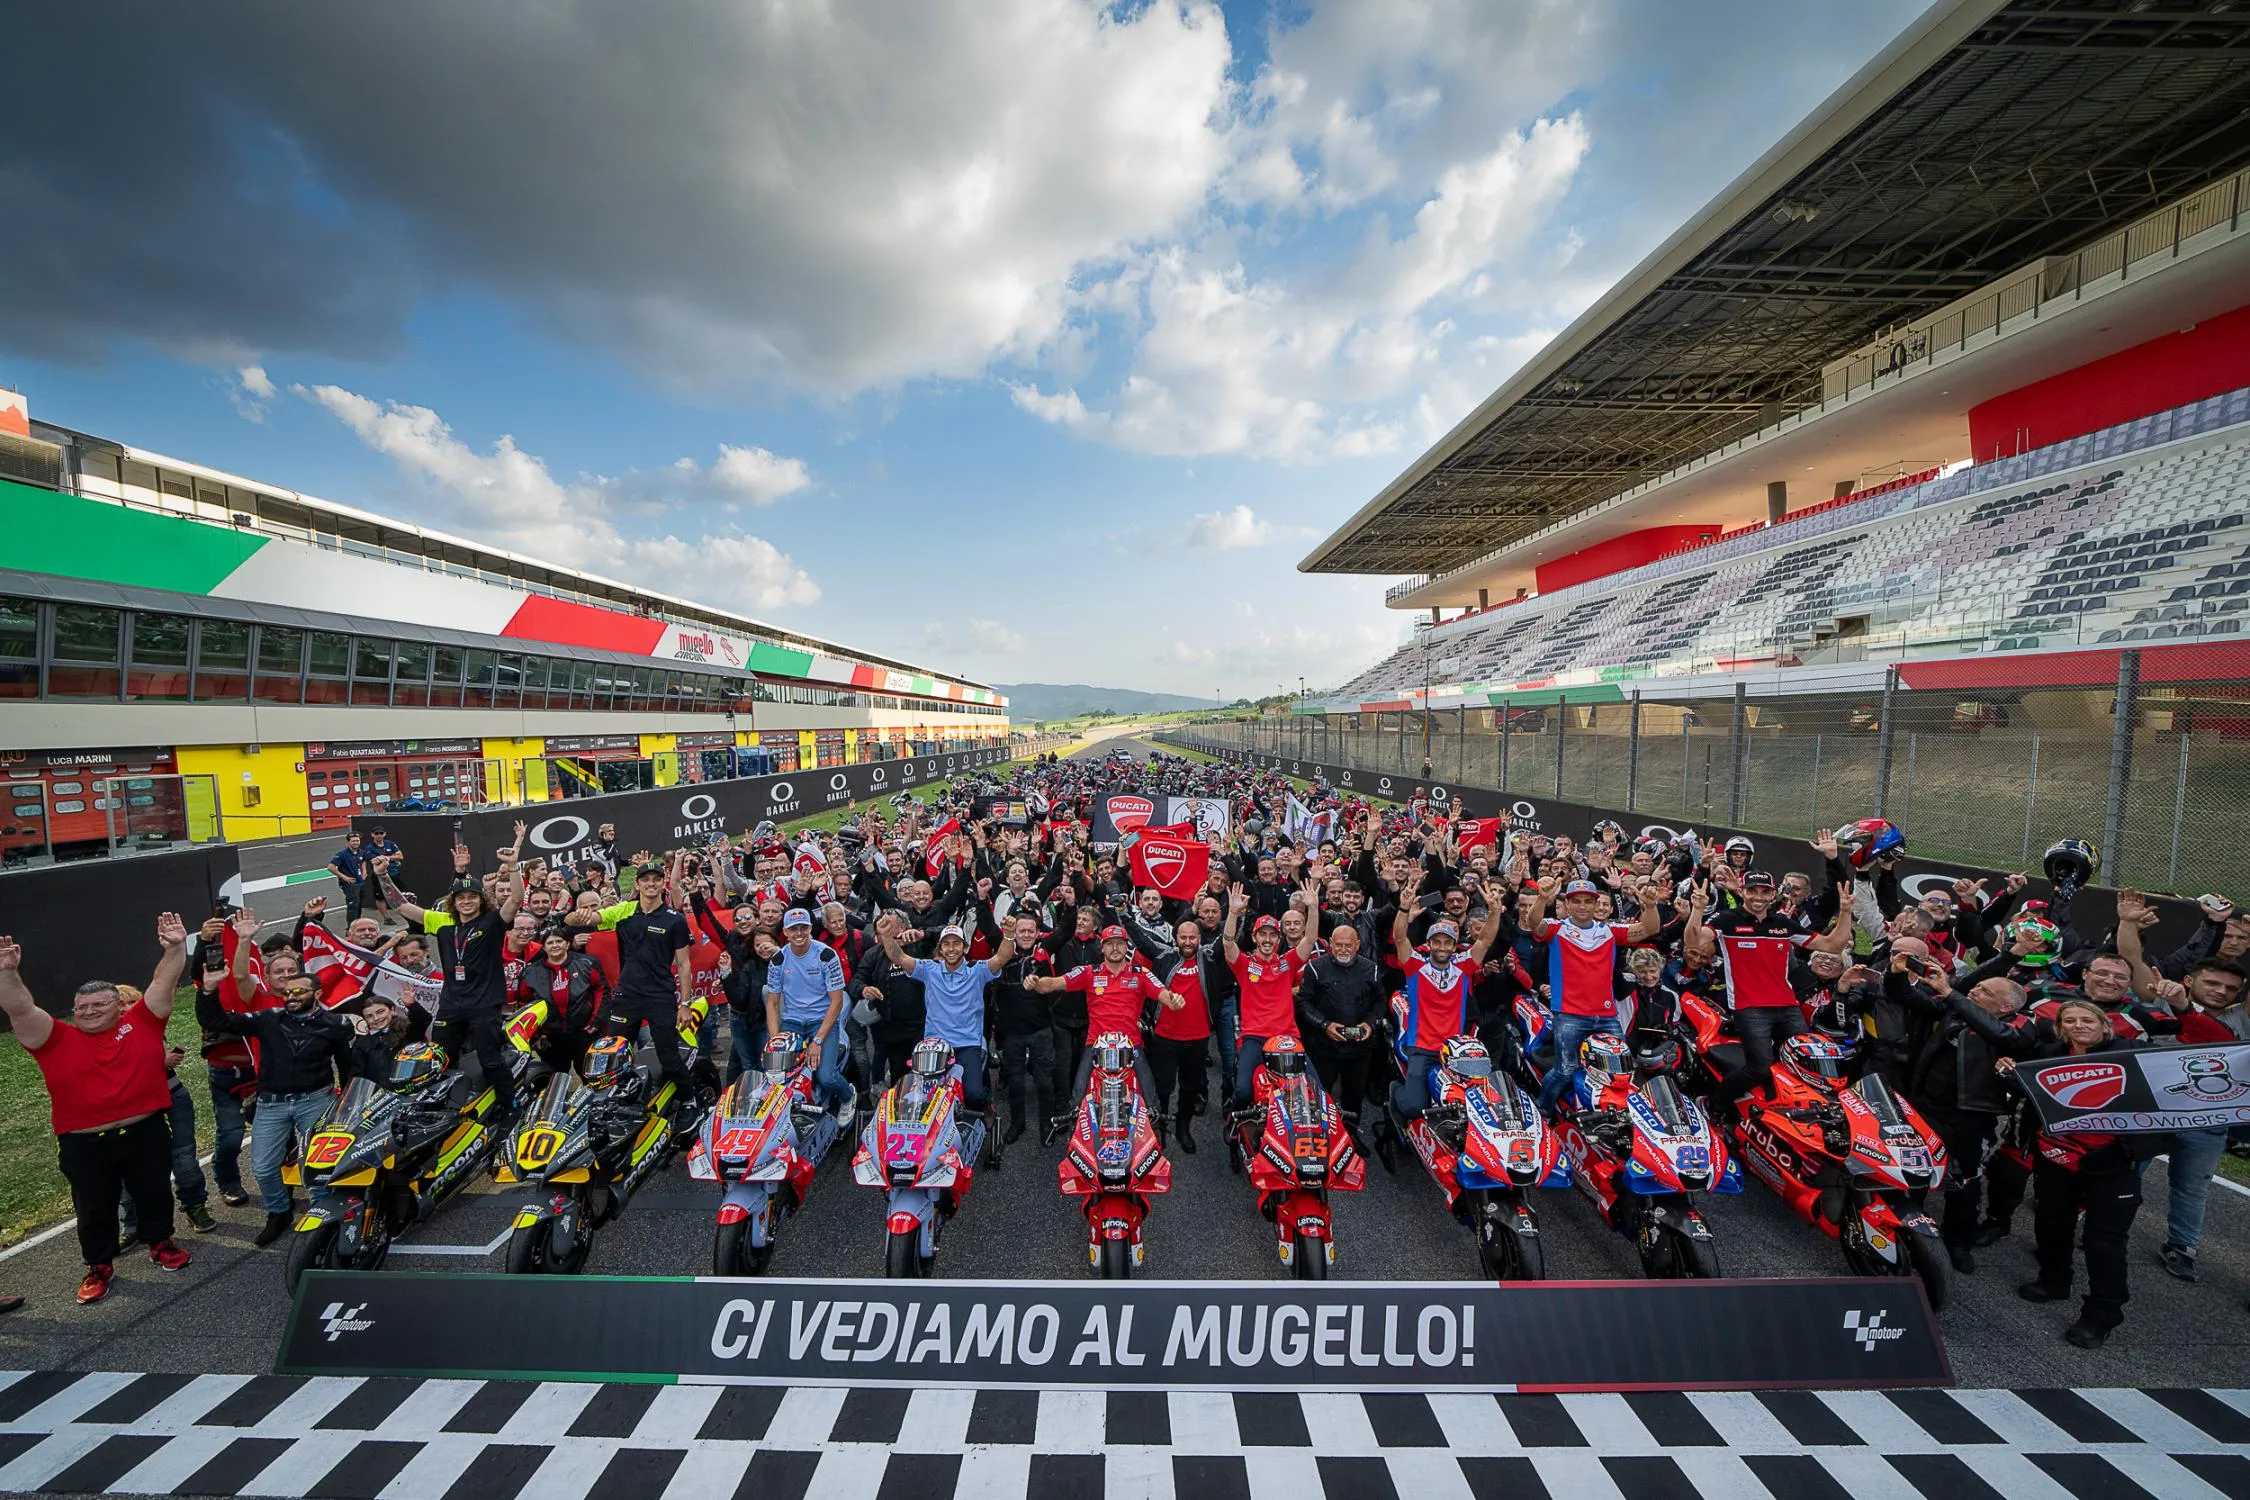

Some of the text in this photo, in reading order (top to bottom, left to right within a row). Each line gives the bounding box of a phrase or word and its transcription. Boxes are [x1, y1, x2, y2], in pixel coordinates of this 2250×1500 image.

[679, 633, 714, 655] mugello
[48, 754, 112, 765] Luca MARINI
[827, 789, 851, 802] OAKLEY
[870, 781, 888, 791] OAKLEY
[766, 800, 800, 817] OAKLEY
[1112, 802, 1149, 811] DUCATI
[674, 816, 726, 838] OAKLEY
[1510, 819, 1542, 831] AKLEY
[1148, 846, 1182, 859] DUCATI
[508, 1012, 539, 1042] 12
[2046, 1067, 2114, 1086] DUCATI
[1468, 1090, 1492, 1123] OCTO
[1522, 1090, 1532, 1122] OCTO
[1629, 1095, 1658, 1128] OCTO
[1840, 1093, 1868, 1115] FIAMM
[2052, 1115, 2128, 1131] Desmo
[2133, 1113, 2228, 1129] Owners
[520, 1131, 556, 1161] 10
[713, 1128, 765, 1157] 49
[1493, 1131, 1537, 1139] PRAMAC
[1660, 1136, 1705, 1145] PRAMAC
[307, 1137, 352, 1163] 12
[350, 1138, 388, 1160] mooney
[557, 1138, 585, 1165] mooney
[885, 1133, 926, 1161] 23
[1097, 1140, 1132, 1164] 43
[1294, 1137, 1328, 1158] 63
[1475, 1134, 1498, 1168] PRAMAC
[1507, 1139, 1536, 1164] 5
[1676, 1146, 1710, 1170] 89
[1855, 1144, 1888, 1162] Lenovo
[1070, 1150, 1095, 1179] Lenovo
[1134, 1149, 1159, 1178] Lenovo
[1263, 1144, 1291, 1174] Lenovo
[1333, 1146, 1353, 1174] Lenovo
[1642, 1143, 1669, 1175] PRAMAC
[1899, 1148, 1933, 1169] 51
[1102, 1220, 1129, 1229] Lenovo
[1297, 1217, 1325, 1227] Lenovo
[711, 1299, 1475, 1367] CI VEDIAMO AL MUGELLO!
